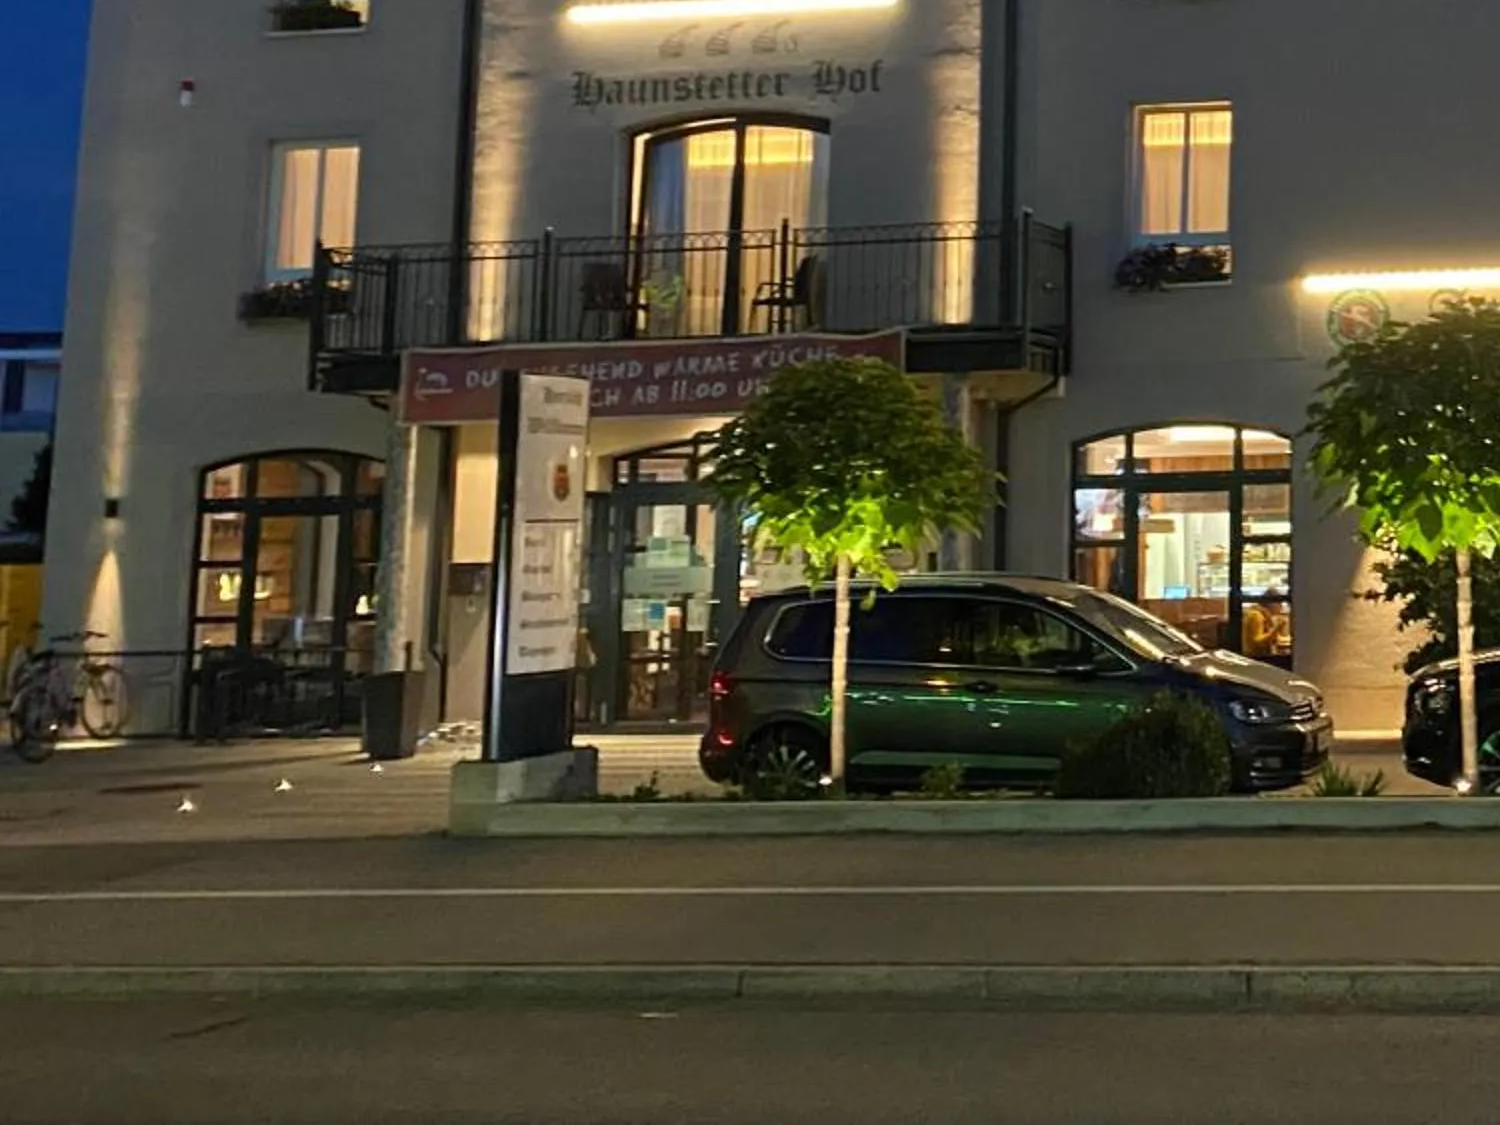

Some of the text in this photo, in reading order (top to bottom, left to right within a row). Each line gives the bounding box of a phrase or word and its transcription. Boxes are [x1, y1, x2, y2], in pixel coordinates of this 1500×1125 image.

[572, 59, 884, 110] Haunstetter Hof
[632, 384, 660, 405] AB
